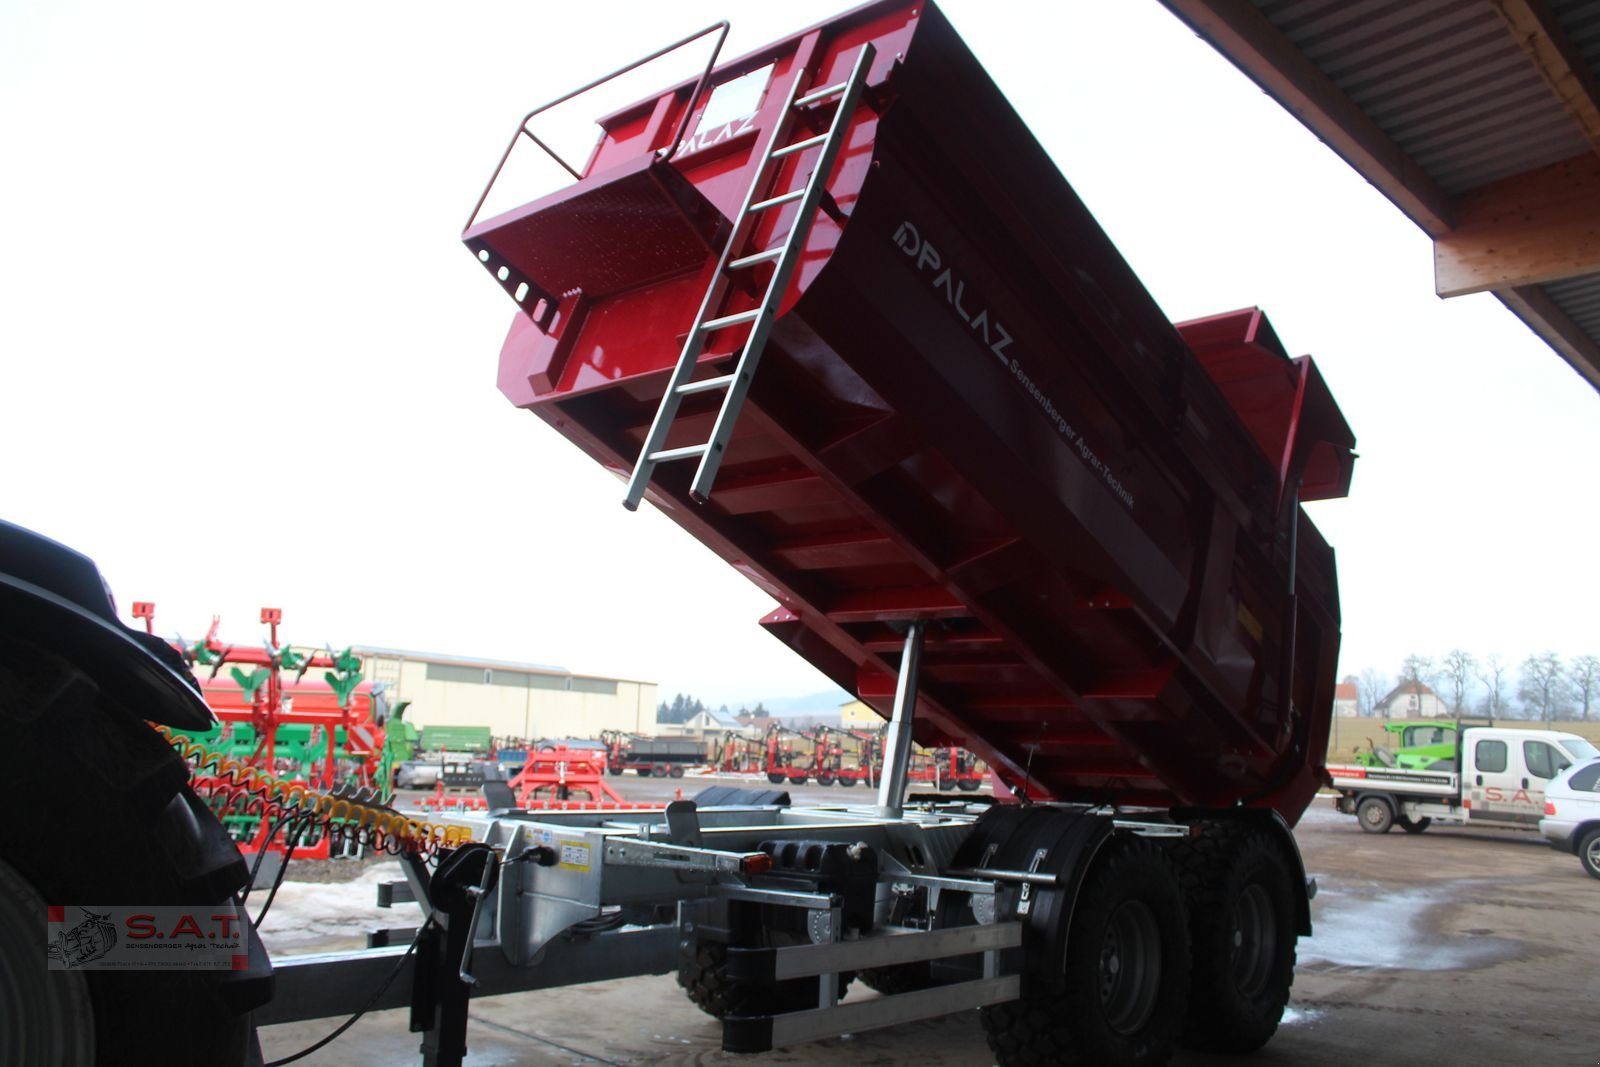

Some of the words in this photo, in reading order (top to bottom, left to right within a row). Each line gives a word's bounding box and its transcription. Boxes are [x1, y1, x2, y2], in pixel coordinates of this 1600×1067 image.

[1010, 359, 1077, 440] Sensenberger
[1075, 437, 1134, 510] Agrar-Technik
[1485, 786, 1544, 804] S.A.
